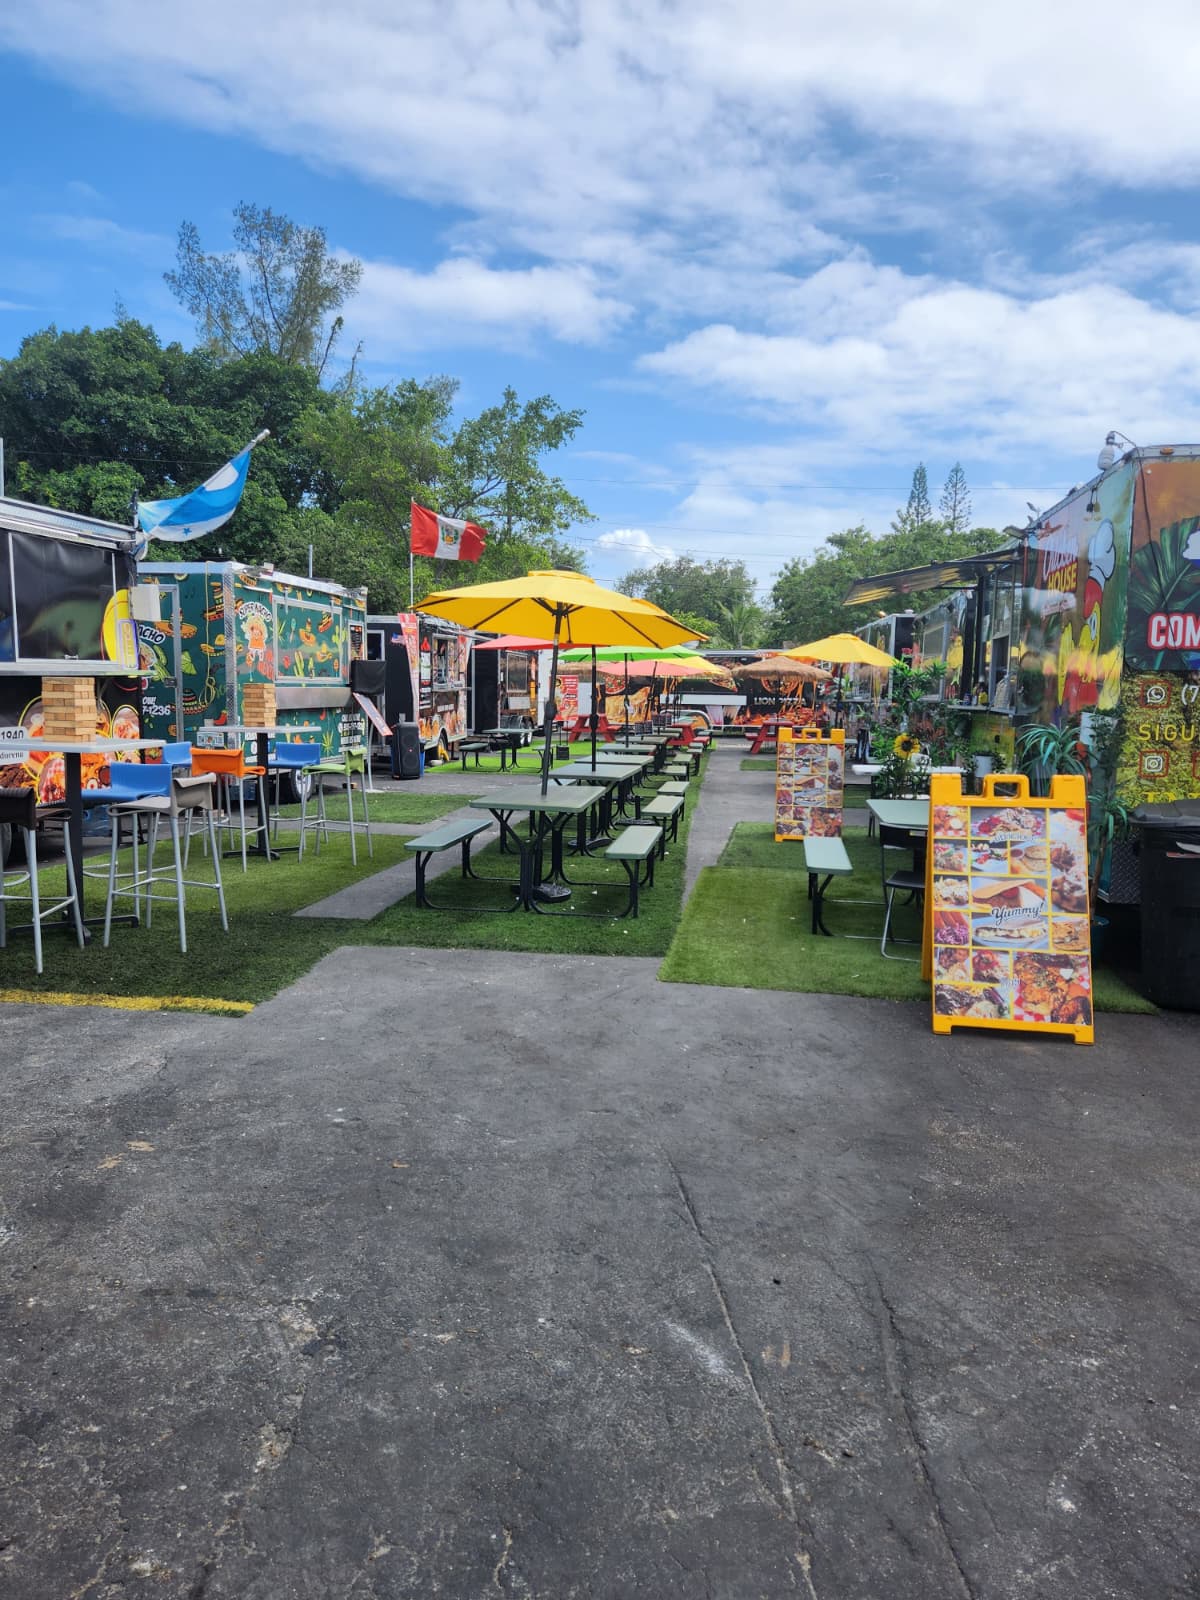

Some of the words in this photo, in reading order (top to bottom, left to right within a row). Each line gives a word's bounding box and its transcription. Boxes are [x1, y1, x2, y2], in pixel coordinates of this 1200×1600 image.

[1048, 561, 1078, 593] HOUSE
[754, 697, 776, 705] LION
[1138, 723, 1195, 742] SIGU
[991, 901, 1045, 926] Yummy!
